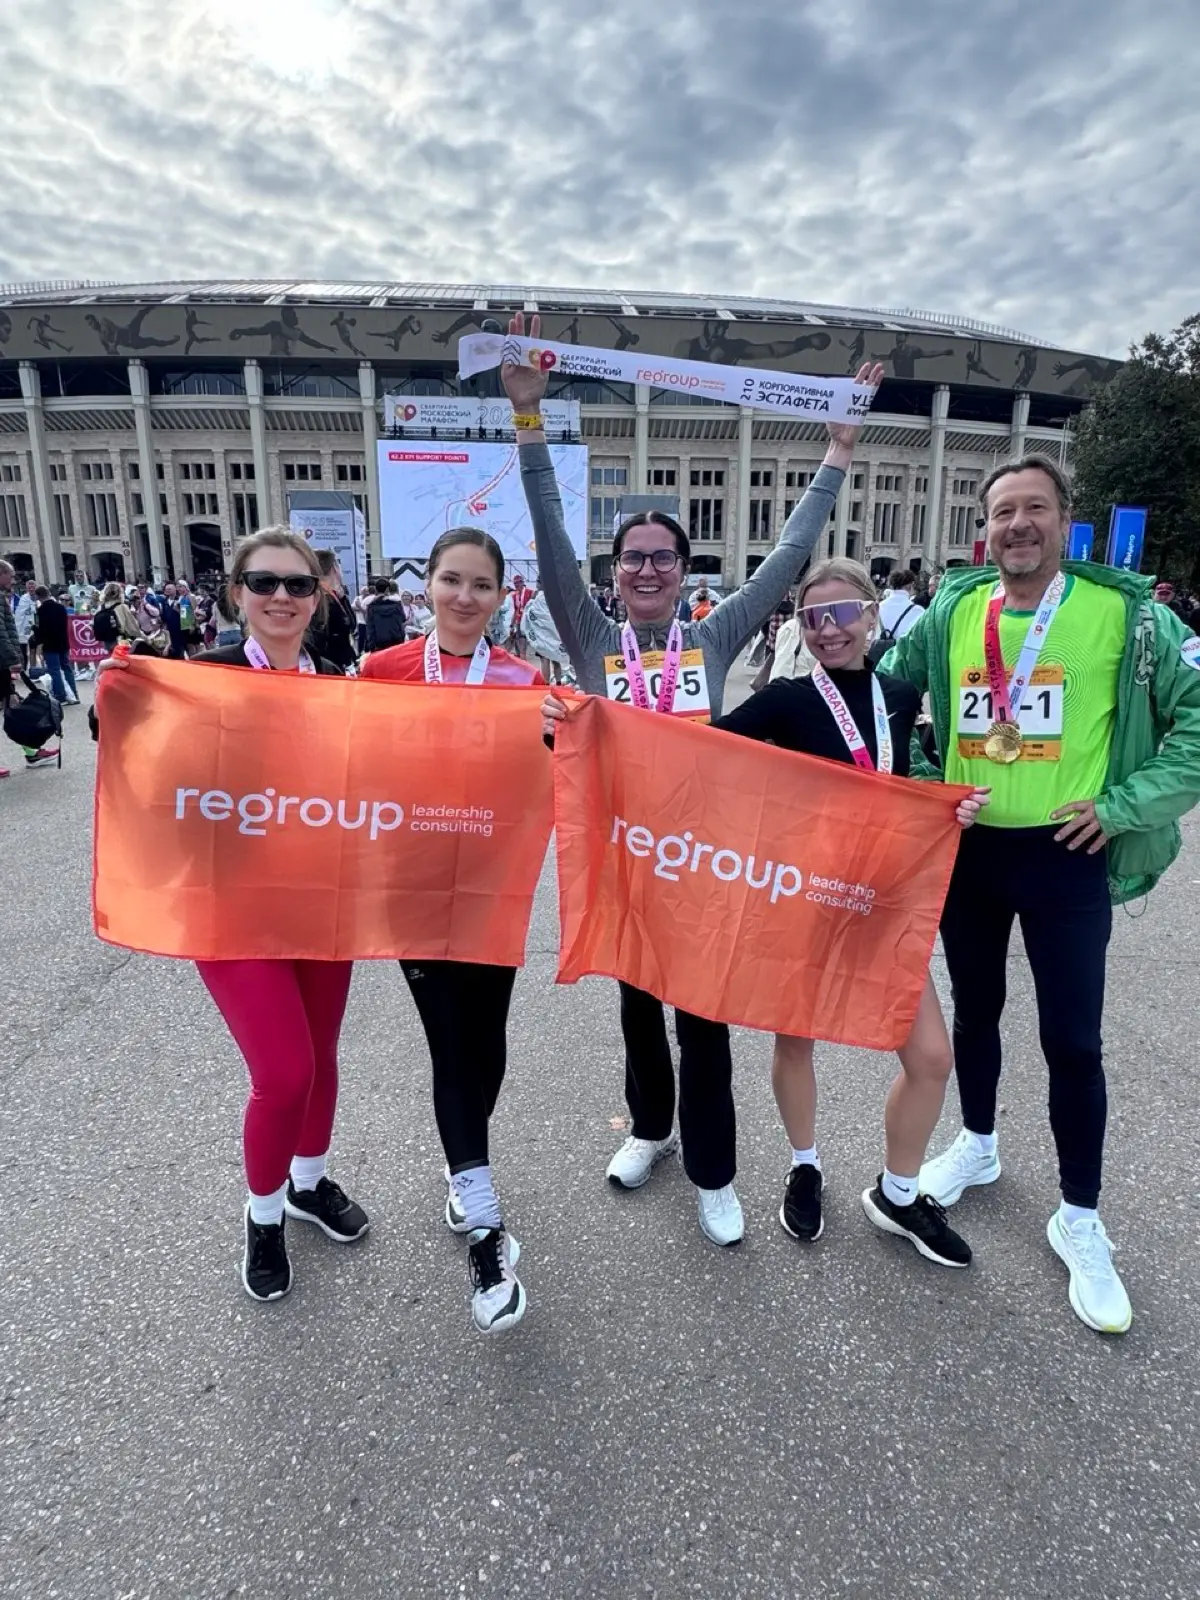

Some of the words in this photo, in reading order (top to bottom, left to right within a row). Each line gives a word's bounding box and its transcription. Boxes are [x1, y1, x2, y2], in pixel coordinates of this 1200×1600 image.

[560, 360, 622, 377] МОСКОВСКИЙ
[636, 369, 700, 389] regroup
[740, 378, 755, 401] 210
[758, 380, 835, 399] КОРПОРАТИВНАЯ
[756, 391, 830, 412] ЭСТАФЕТА
[475, 405, 513, 425] 202
[69, 648, 108, 656] YRUN
[613, 670, 701, 703] 20-5
[662, 661, 677, 713] ЭСТАФЕТА
[819, 672, 860, 744] MARATHON
[963, 690, 1051, 720] 21-1
[175, 787, 404, 840] regroup
[411, 803, 495, 821] leadership
[410, 820, 494, 837] consulting
[610, 815, 802, 904] regroup
[808, 872, 876, 900] leadership
[805, 890, 873, 916] consulting
